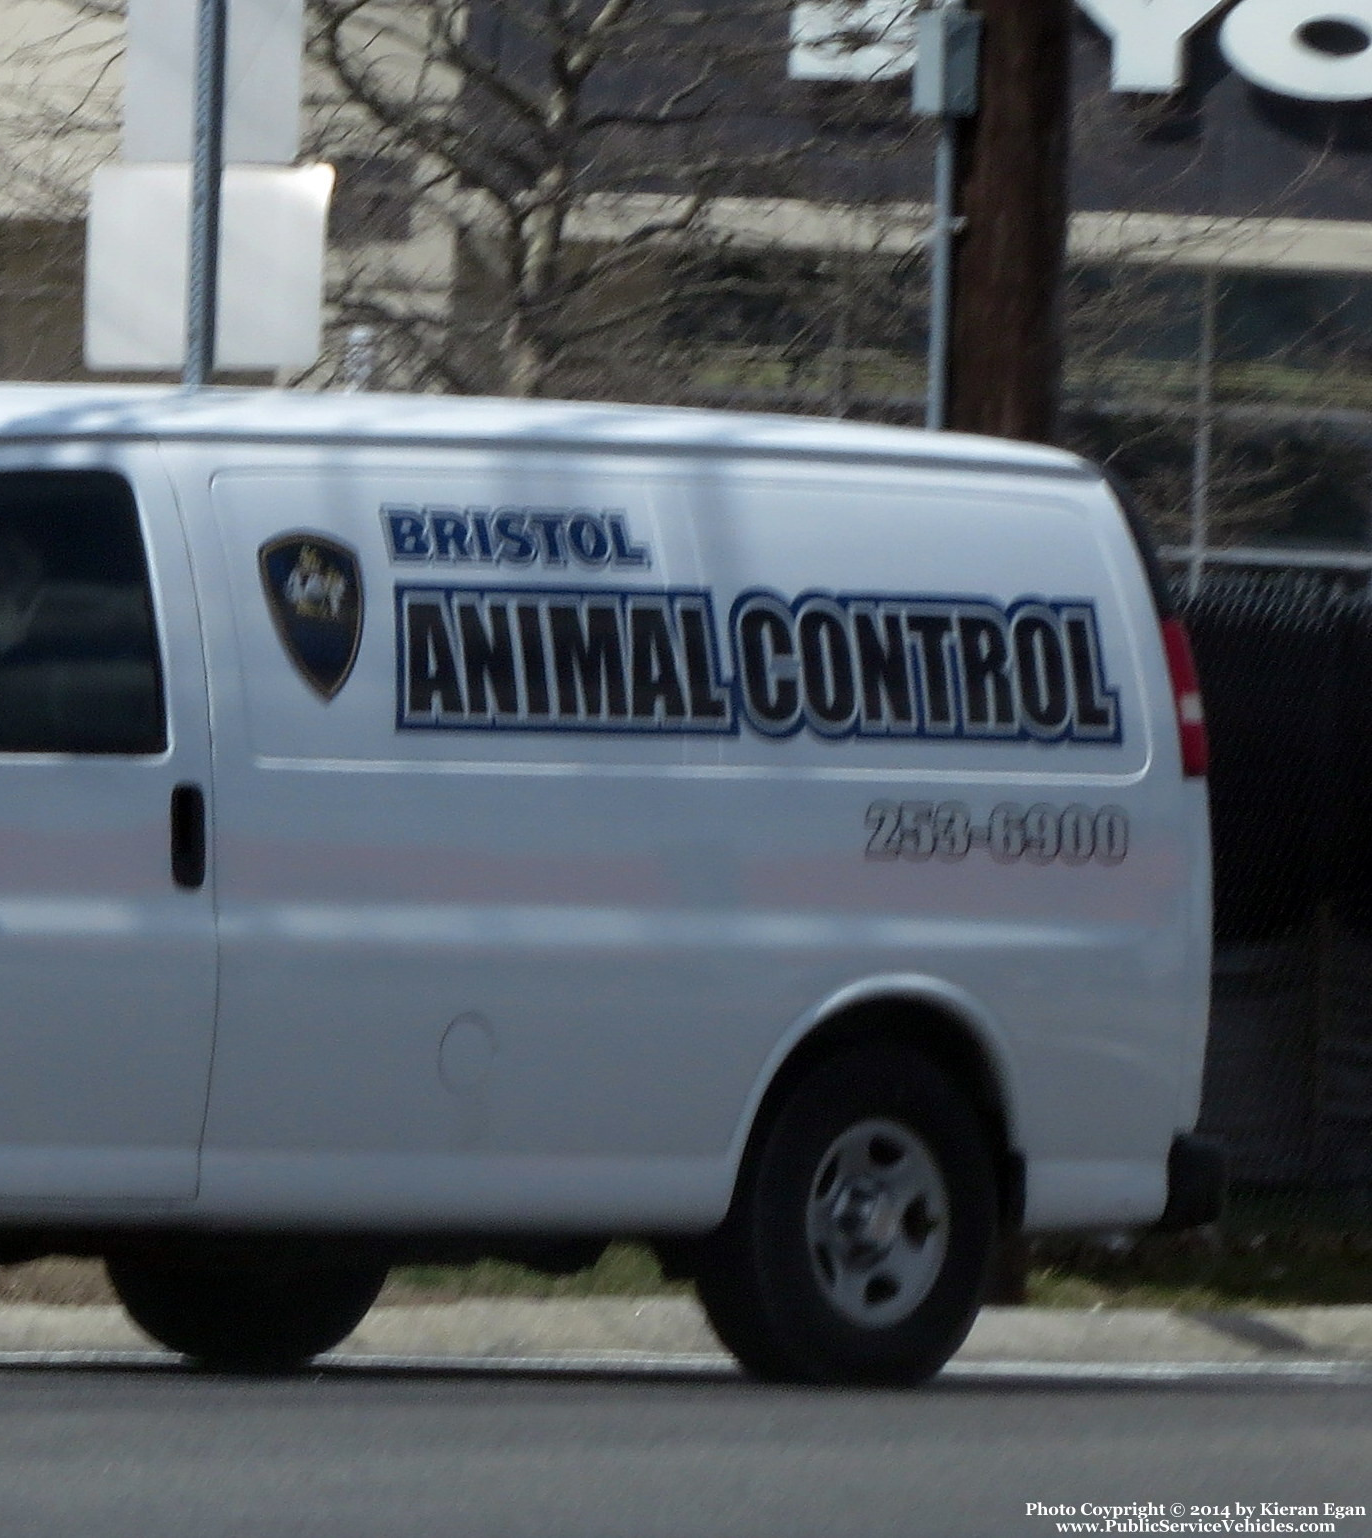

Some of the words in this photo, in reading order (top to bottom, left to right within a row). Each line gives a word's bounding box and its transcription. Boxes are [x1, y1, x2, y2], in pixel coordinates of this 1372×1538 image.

[380, 508, 651, 570] BRISTOL
[396, 581, 737, 732] ANIMAL
[730, 588, 1121, 744] CONTROL
[864, 800, 1129, 865] 253-6900
